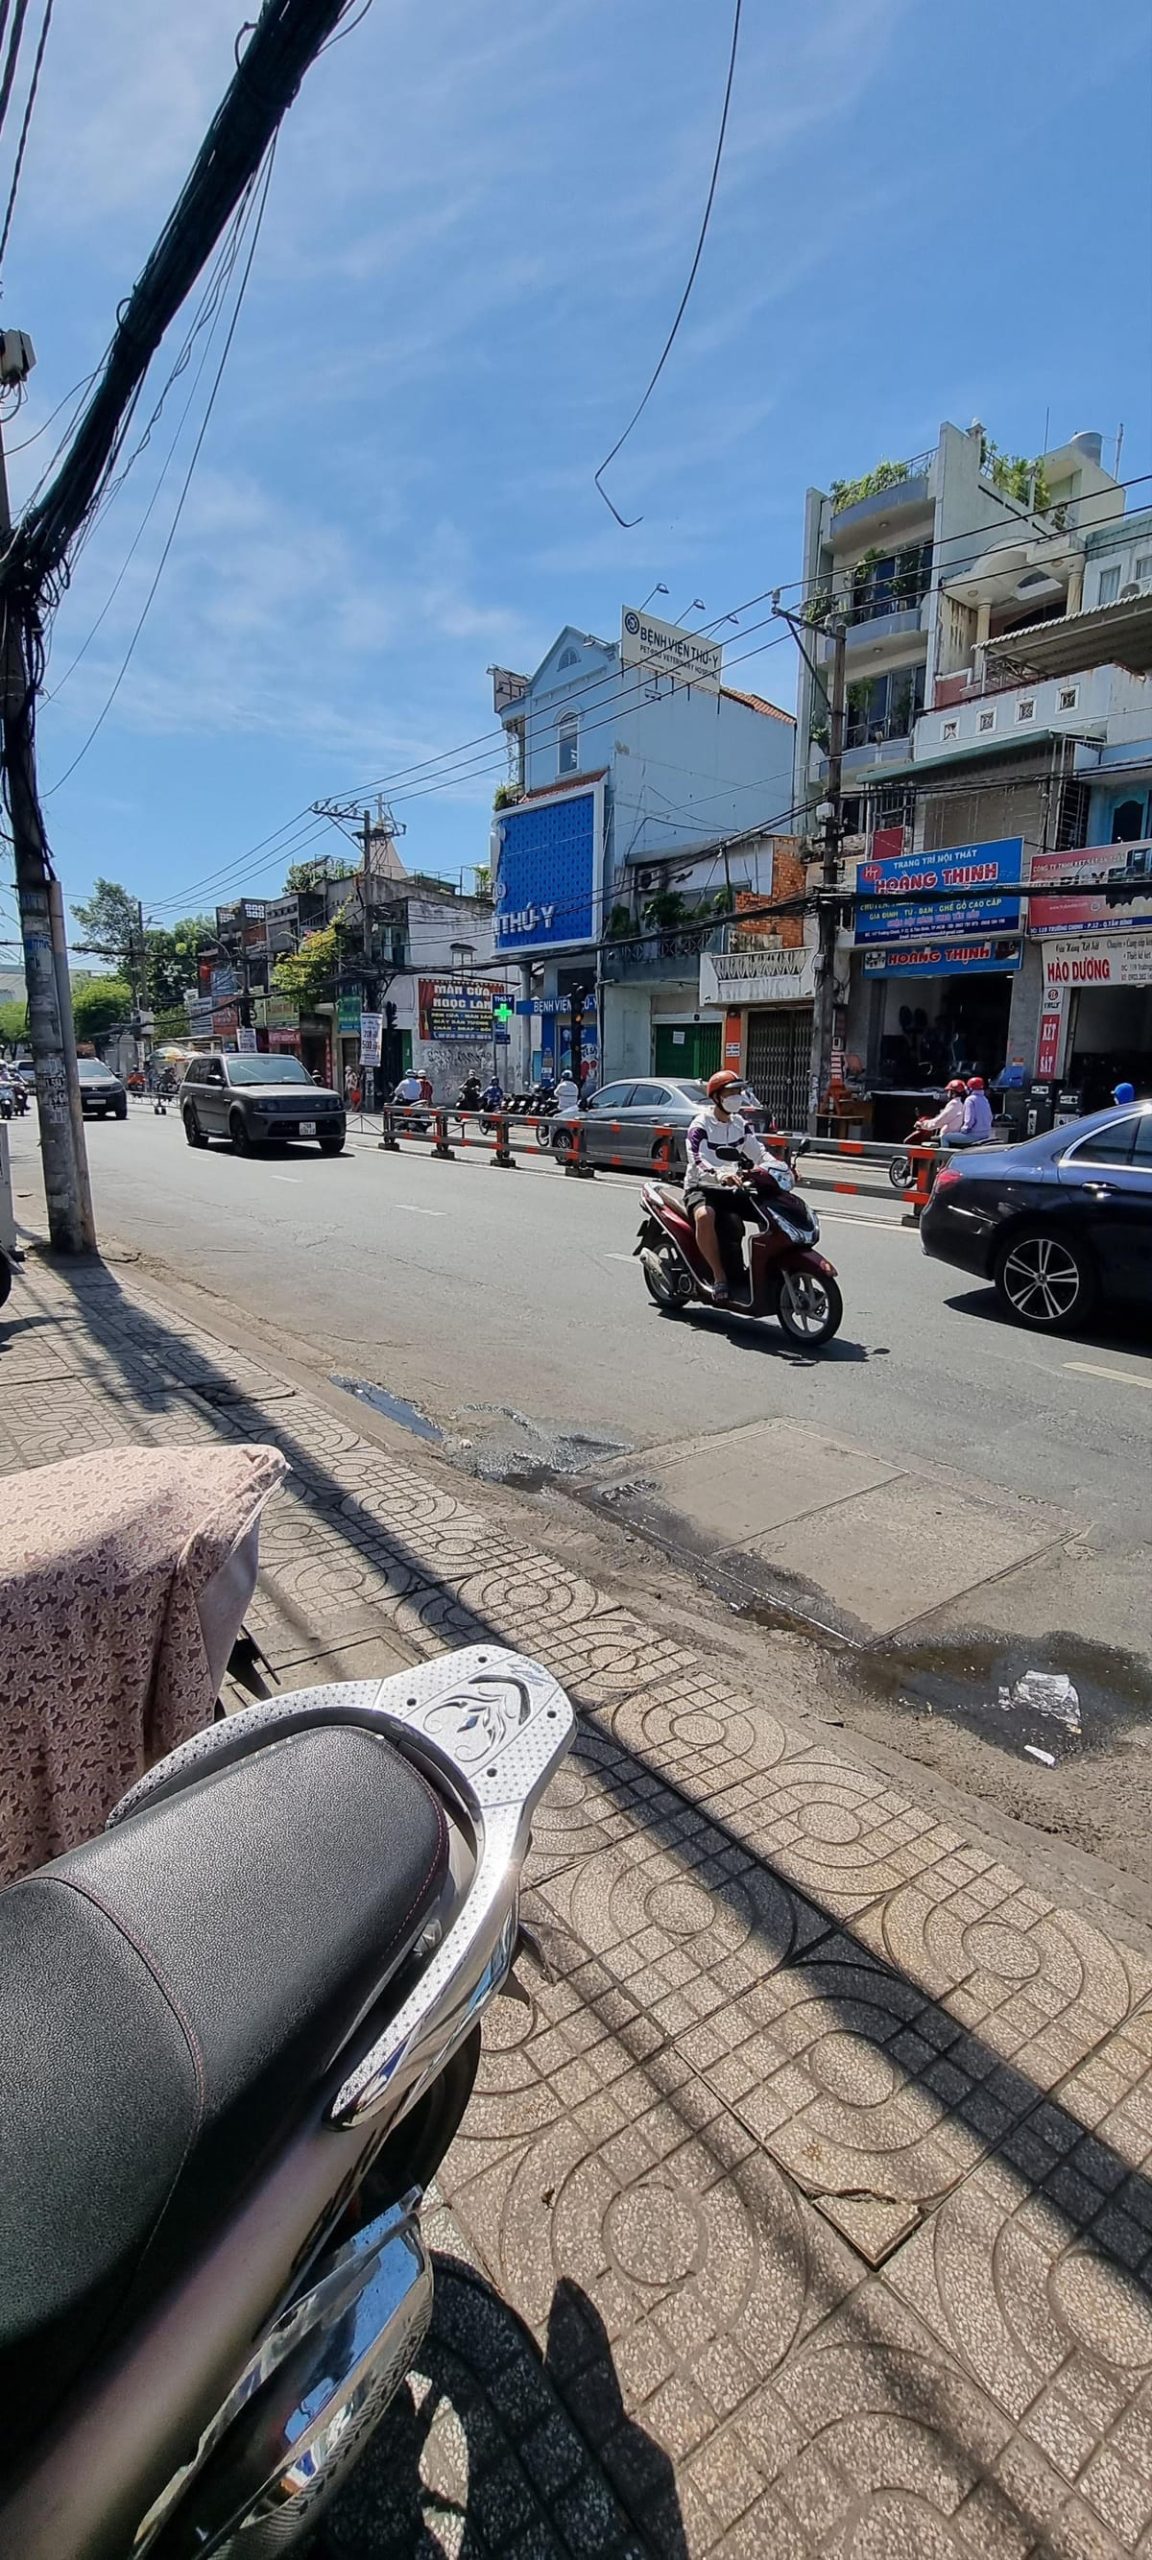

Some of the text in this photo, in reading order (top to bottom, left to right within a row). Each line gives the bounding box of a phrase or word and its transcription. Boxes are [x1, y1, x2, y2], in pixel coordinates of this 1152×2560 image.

[640, 626, 667, 648] BỆNH
[893, 859, 920, 870] TRANG
[922, 856, 936, 865] TRÍ
[937, 853, 952, 863] NỘI
[875, 862, 998, 895] HOÀNG THỊNH
[968, 900, 984, 908] CAO
[500, 902, 554, 935] THÚ-Y
[945, 946, 992, 965] THỊNH
[1047, 957, 1111, 983] HÀO DƯƠNG
[433, 984, 463, 996] MÀN
[433, 998, 466, 1010] NGỌC
